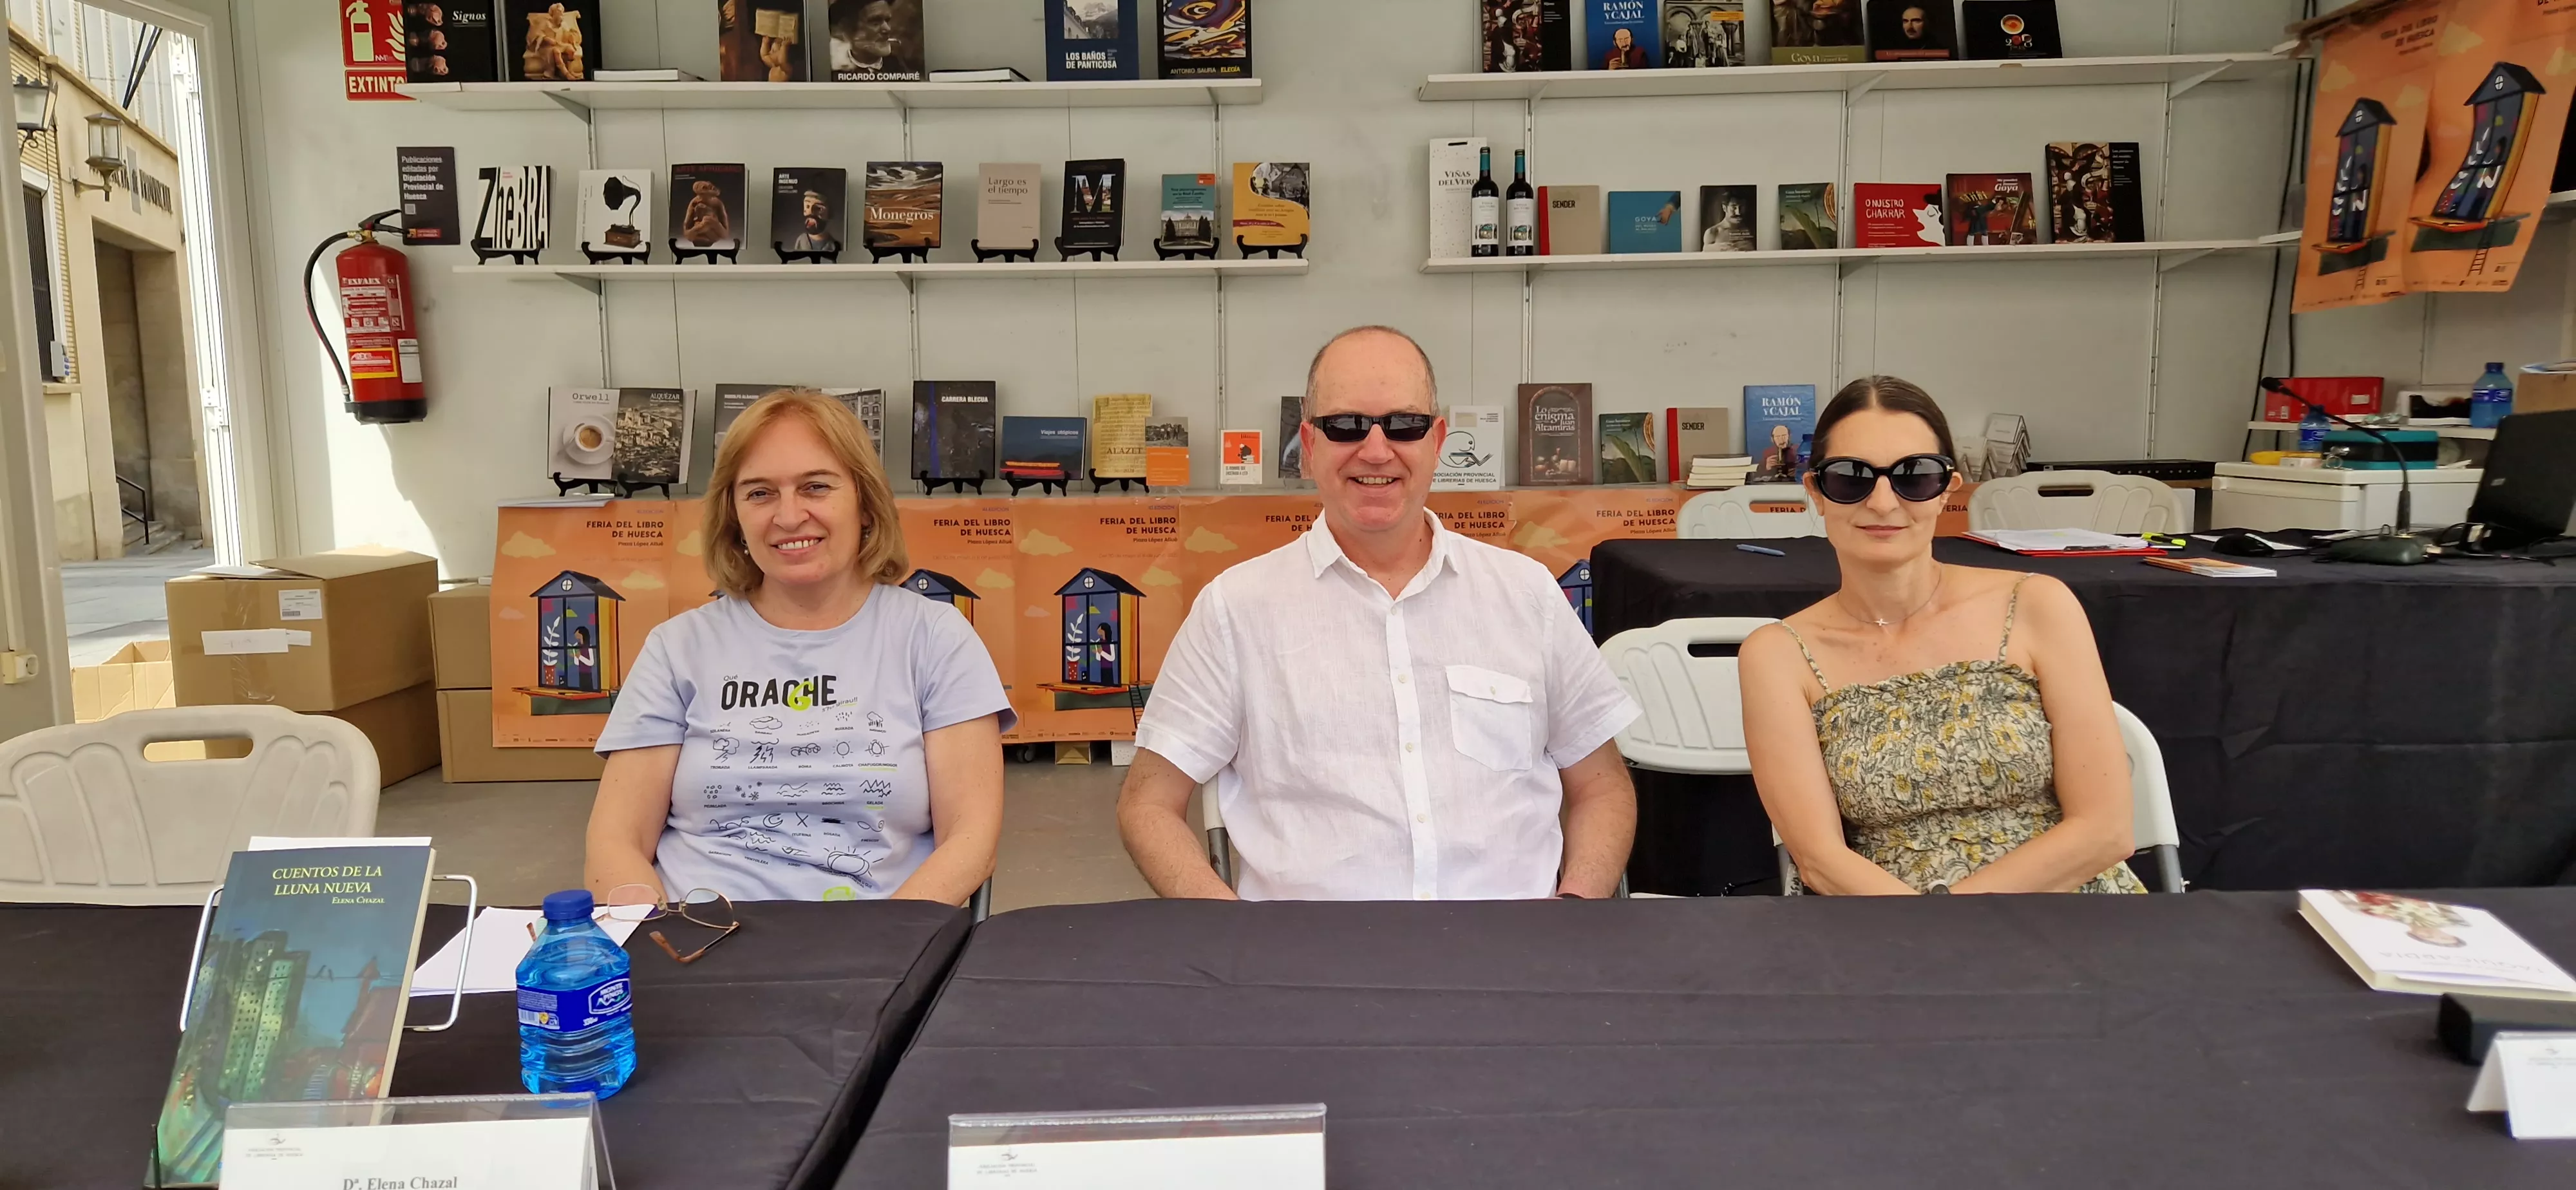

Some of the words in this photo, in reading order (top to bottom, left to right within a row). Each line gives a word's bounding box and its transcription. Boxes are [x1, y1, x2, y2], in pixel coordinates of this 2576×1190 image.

[452, 10, 486, 24] Signos
[1611, 10, 1645, 20] CAJAL
[1066, 52, 1080, 61] LOS
[1081, 51, 1106, 61] BAÑOS
[1077, 60, 1117, 69] PANTICOSA
[878, 71, 920, 80] COMPAIRÉ
[348, 76, 406, 93] EXTINT
[402, 174, 436, 182] Diputación
[1444, 169, 1471, 178] VIÑAS
[989, 177, 1014, 187] Largo
[1454, 178, 1478, 186] VERO
[988, 185, 996, 194] el
[998, 186, 1028, 196] tiempo
[1994, 183, 2018, 193] Goya
[1070, 174, 1115, 213] M
[1552, 200, 1575, 209] SENDER
[1865, 198, 1871, 207] O
[1871, 198, 1904, 208] NUESTRO
[870, 208, 934, 223] Monegros
[1866, 209, 1906, 219] CHARRAR
[572, 393, 610, 401] Orwell
[1762, 395, 1801, 406] RAMÓN
[1769, 406, 1802, 417] CAJAL
[1535, 411, 1575, 423] enigma
[1535, 423, 1575, 431] Altamiras
[1681, 422, 1705, 430] SENDER
[721, 675, 837, 710] ORACHE
[272, 866, 339, 879] CUENTOS
[342, 866, 362, 877] DE
[365, 865, 382, 876] LA
[274, 883, 319, 896] LLUNA
[323, 882, 372, 893] NUEVA
[368, 1178, 405, 1189] Elena
[410, 1176, 458, 1189] Chazal
